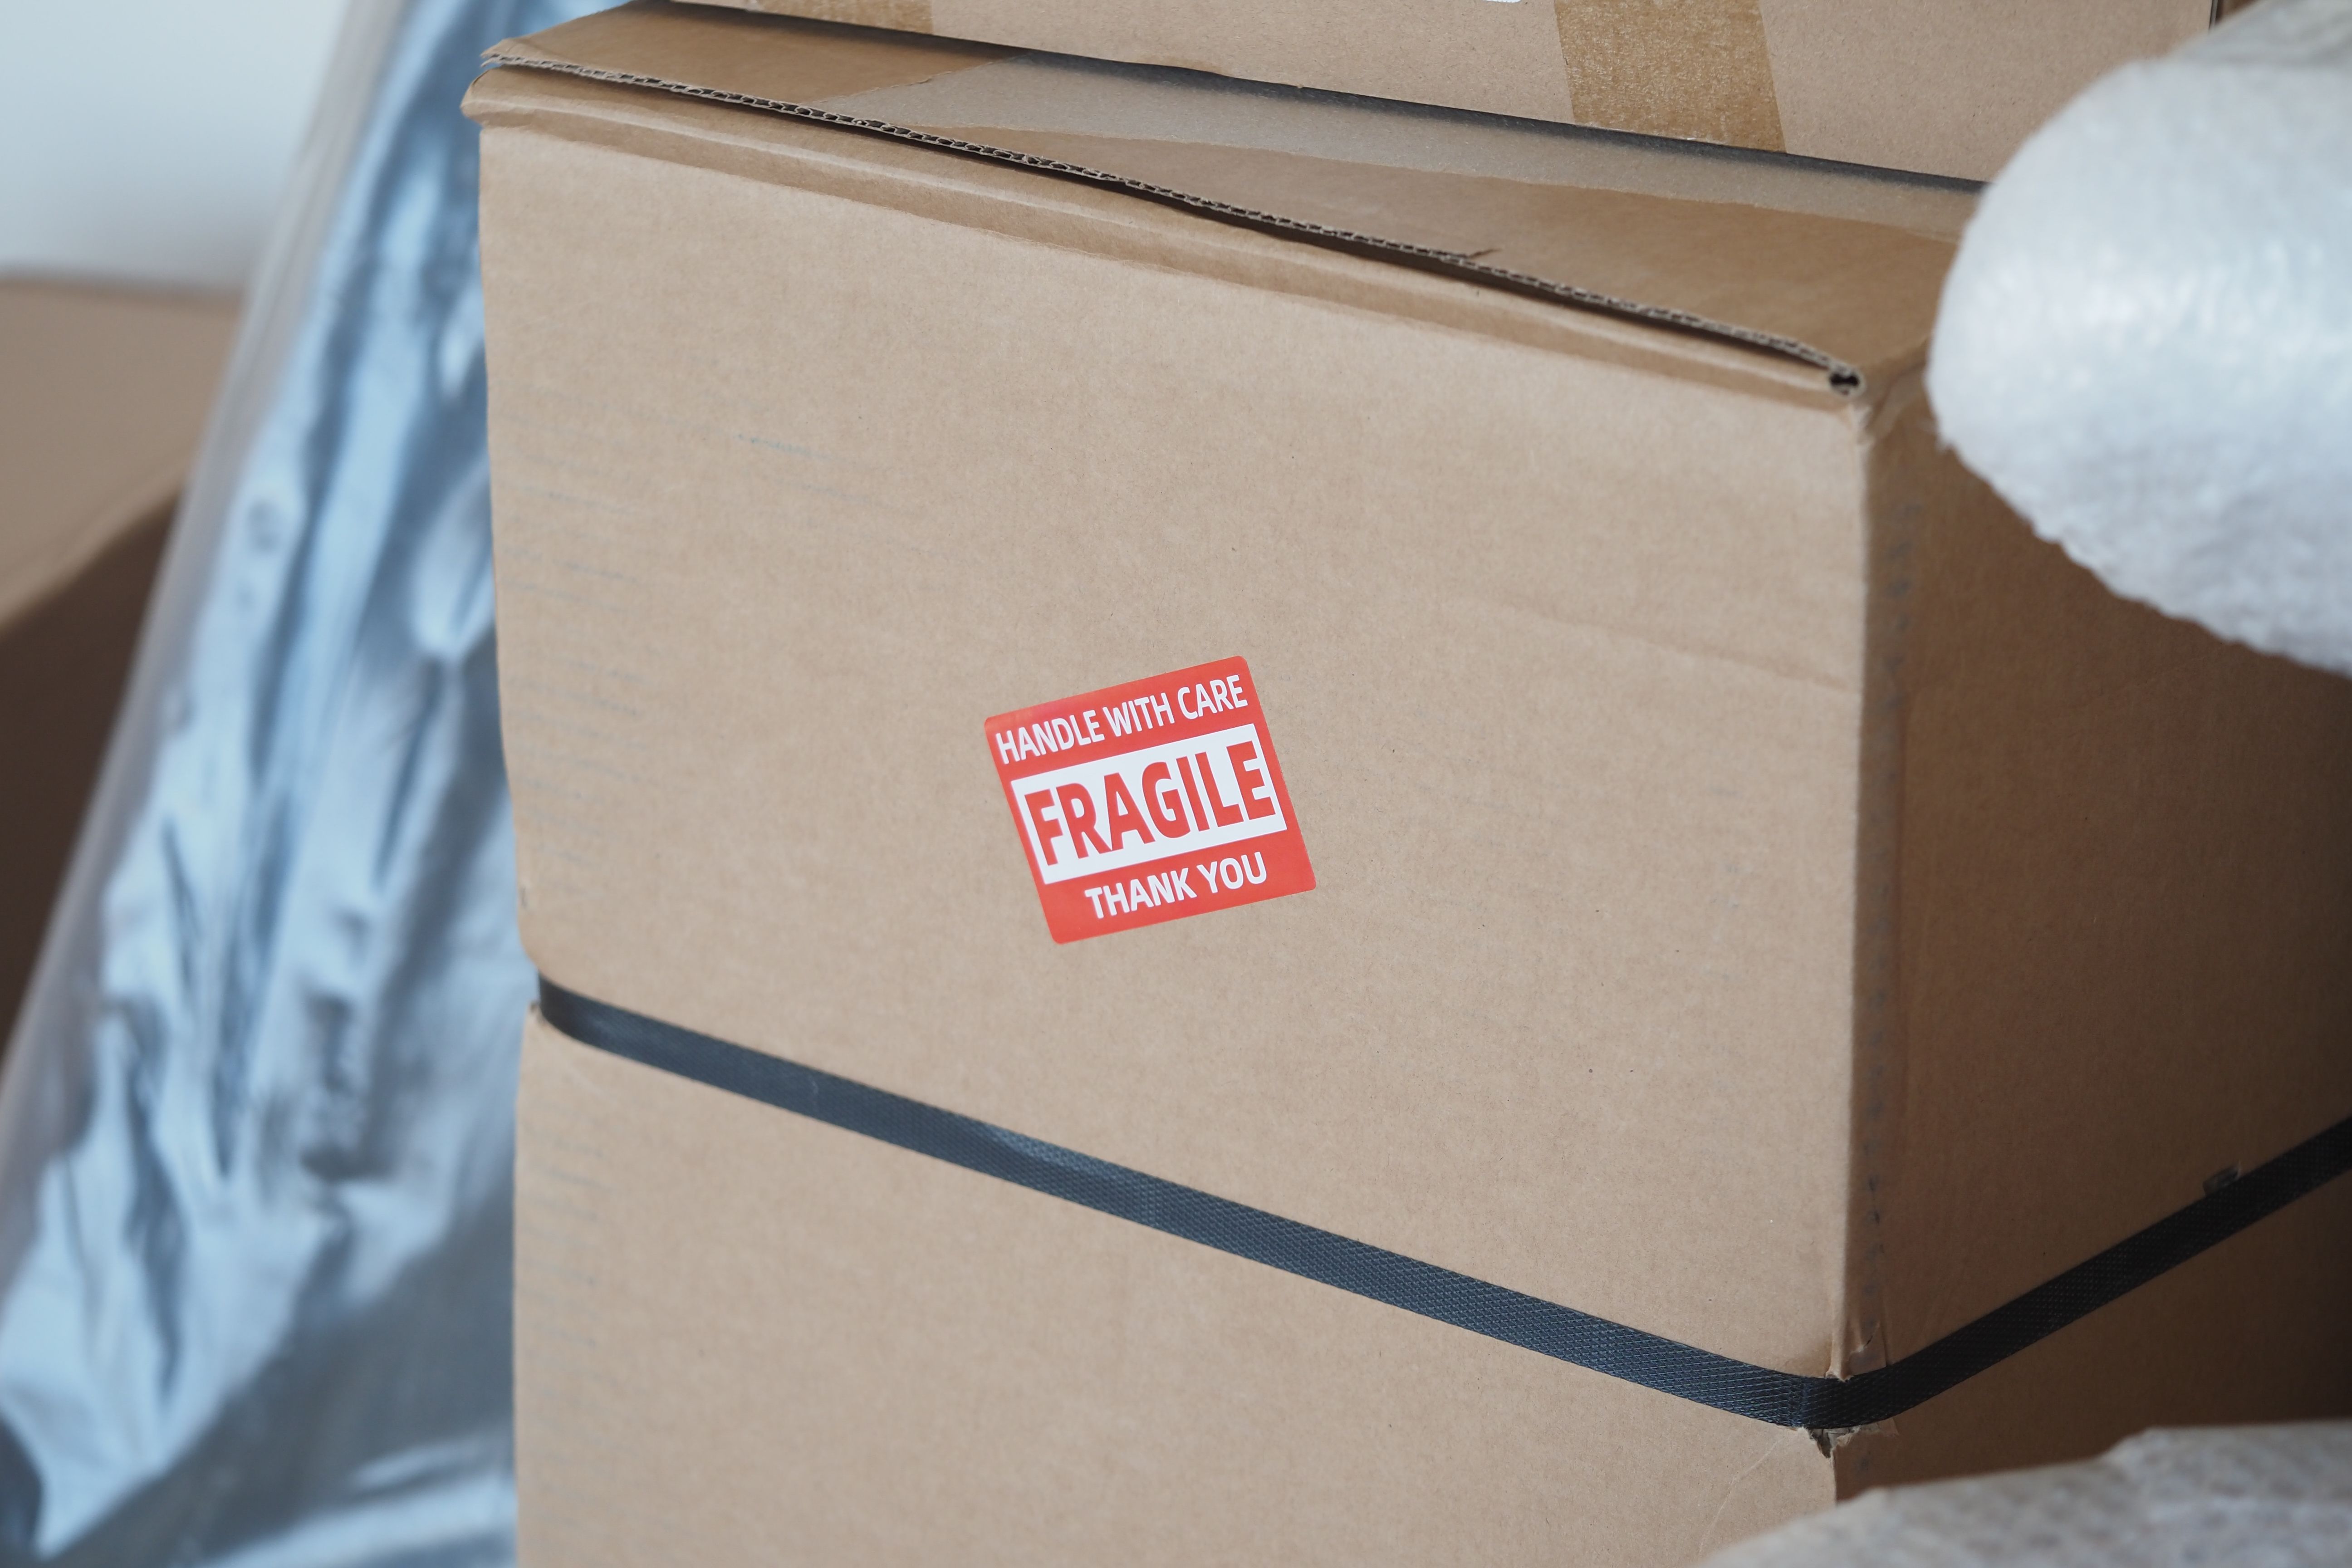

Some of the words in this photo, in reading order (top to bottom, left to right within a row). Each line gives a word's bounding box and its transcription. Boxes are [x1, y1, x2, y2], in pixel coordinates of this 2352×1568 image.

[996, 710, 1105, 764] HANDLE
[1103, 692, 1175, 737] WITH
[1177, 674, 1249, 720] CARE
[1024, 740, 1276, 867] FRAGILE
[1085, 867, 1197, 919] THANK
[1196, 851, 1267, 894] YOU
